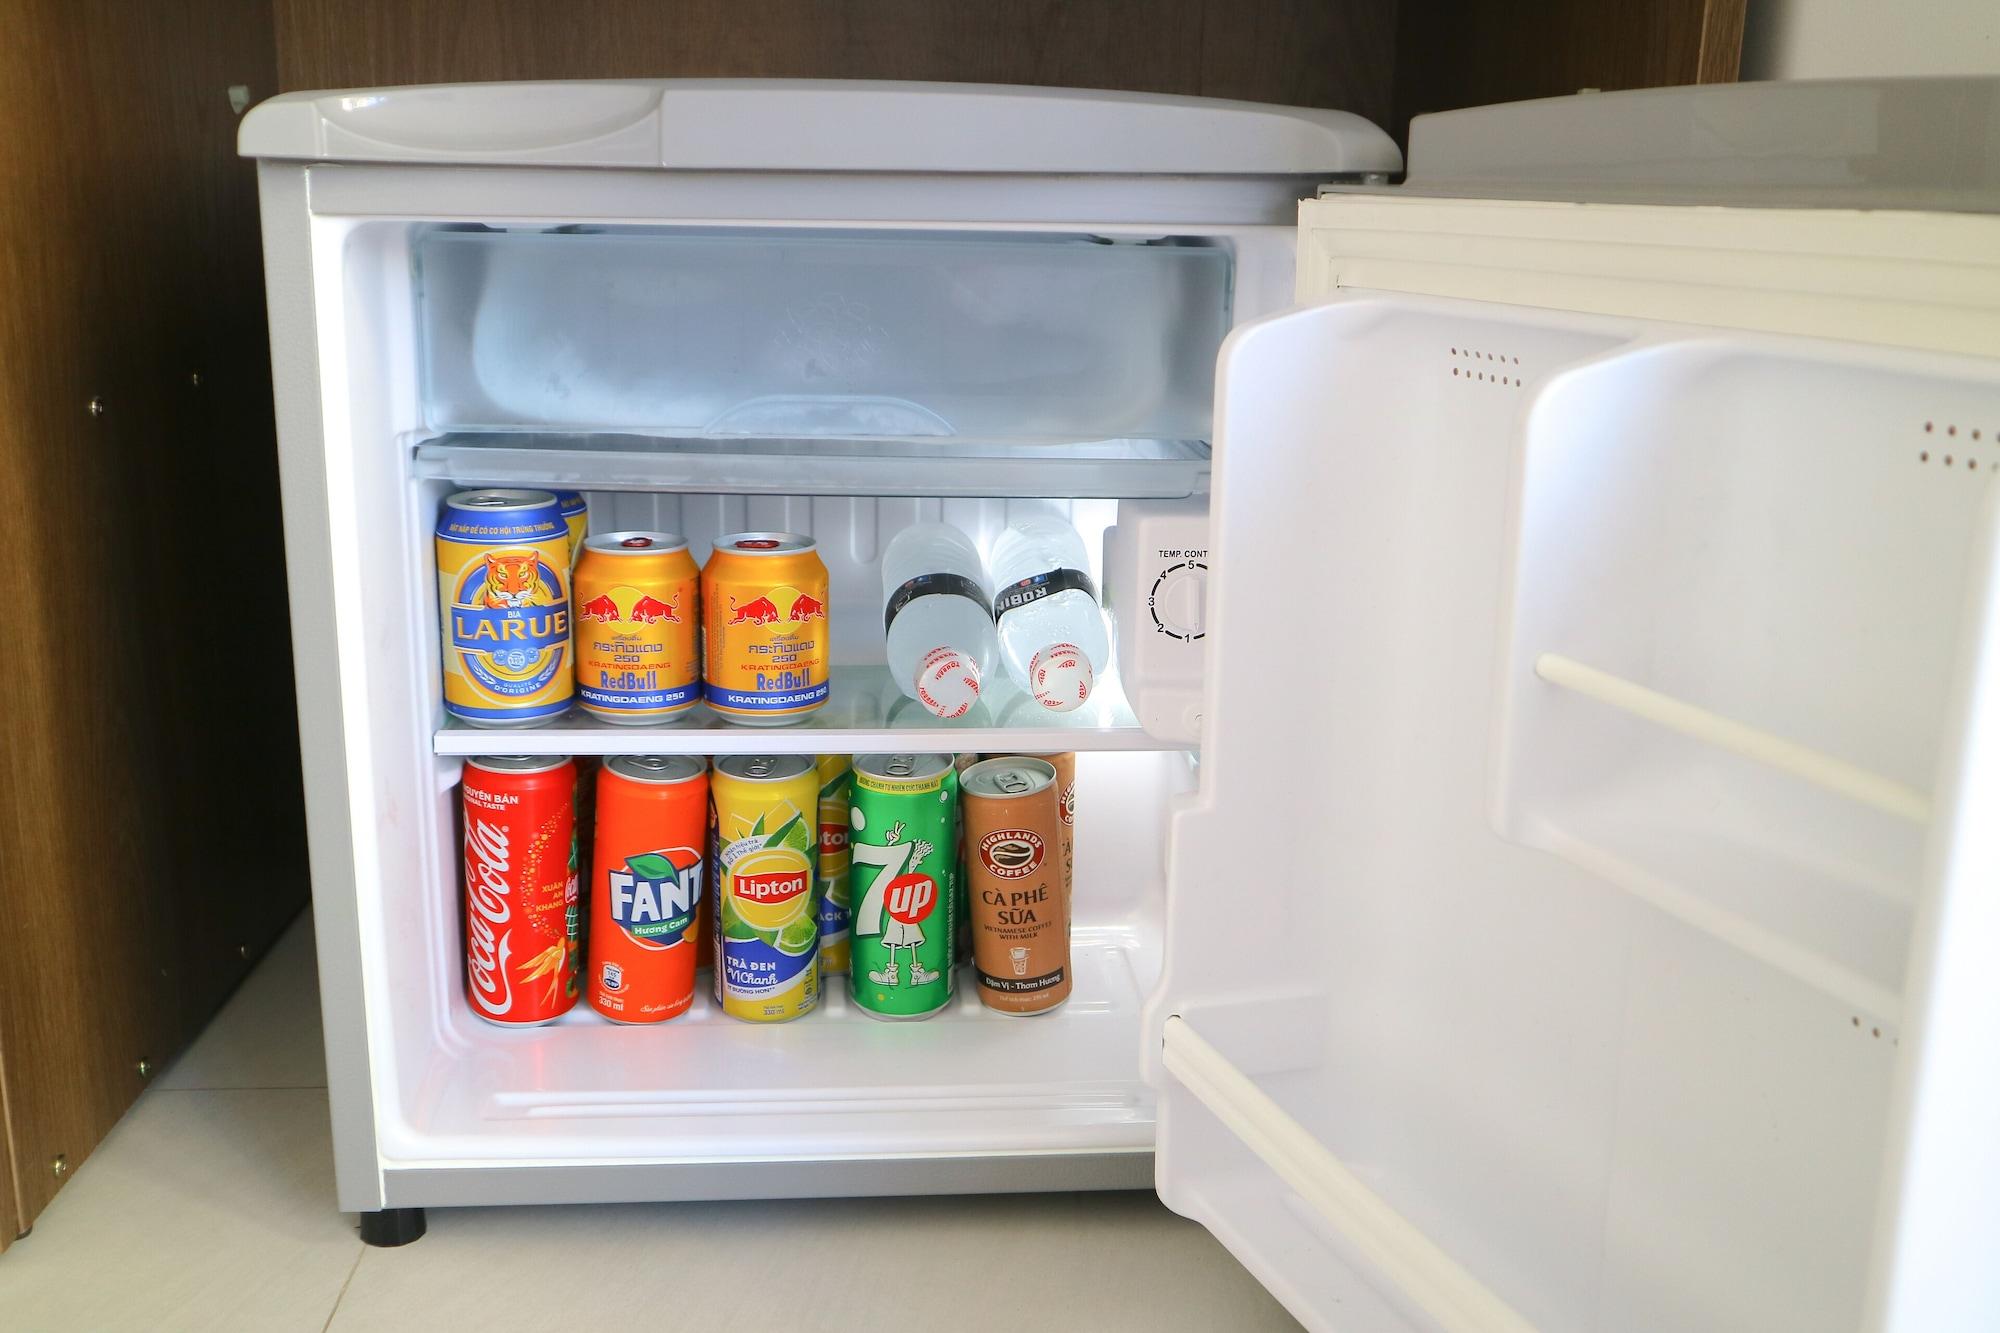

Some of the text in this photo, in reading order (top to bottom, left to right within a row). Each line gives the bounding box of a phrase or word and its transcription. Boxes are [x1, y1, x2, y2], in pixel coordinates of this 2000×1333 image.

[1159, 550, 1181, 558] TEMP.
[1188, 560, 1195, 570] 5
[1160, 570, 1167, 580] 4
[1148, 596, 1155, 606] 3
[456, 611, 567, 641] LARUE
[1157, 623, 1164, 633] 2
[1184, 634, 1190, 643] 1
[614, 655, 640, 663] 250
[741, 659, 820, 671] KRATINGDAENG
[772, 654, 797, 663] 250
[588, 661, 672, 670] KRATINGDAENG
[600, 670, 657, 689] RedBull
[756, 668, 811, 690] RedBull
[494, 683, 541, 694] D'ORIGINE
[581, 689, 685, 703] KRATINGDAENG 250
[728, 691, 815, 704] KRATINGDAENG
[483, 802, 505, 811] TASTE
[981, 832, 1043, 851] HIGHLANDS
[990, 860, 1037, 877] COFFEE
[609, 859, 703, 922] FANT
[740, 878, 803, 899] Lipton
[982, 883, 1048, 906] CÀ PHÊ
[536, 900, 563, 912] KHANG
[998, 908, 1036, 925] SỮA
[634, 917, 688, 935] Hương Cam
[984, 921, 1052, 934] VIETNAMESE COFFEE
[1020, 931, 1038, 939] MILK
[726, 956, 775, 971] TRÀ ĐEN
[741, 971, 778, 985] Chanh
[1015, 981, 1038, 990] Thơm
[599, 996, 624, 1011] 330 ml
